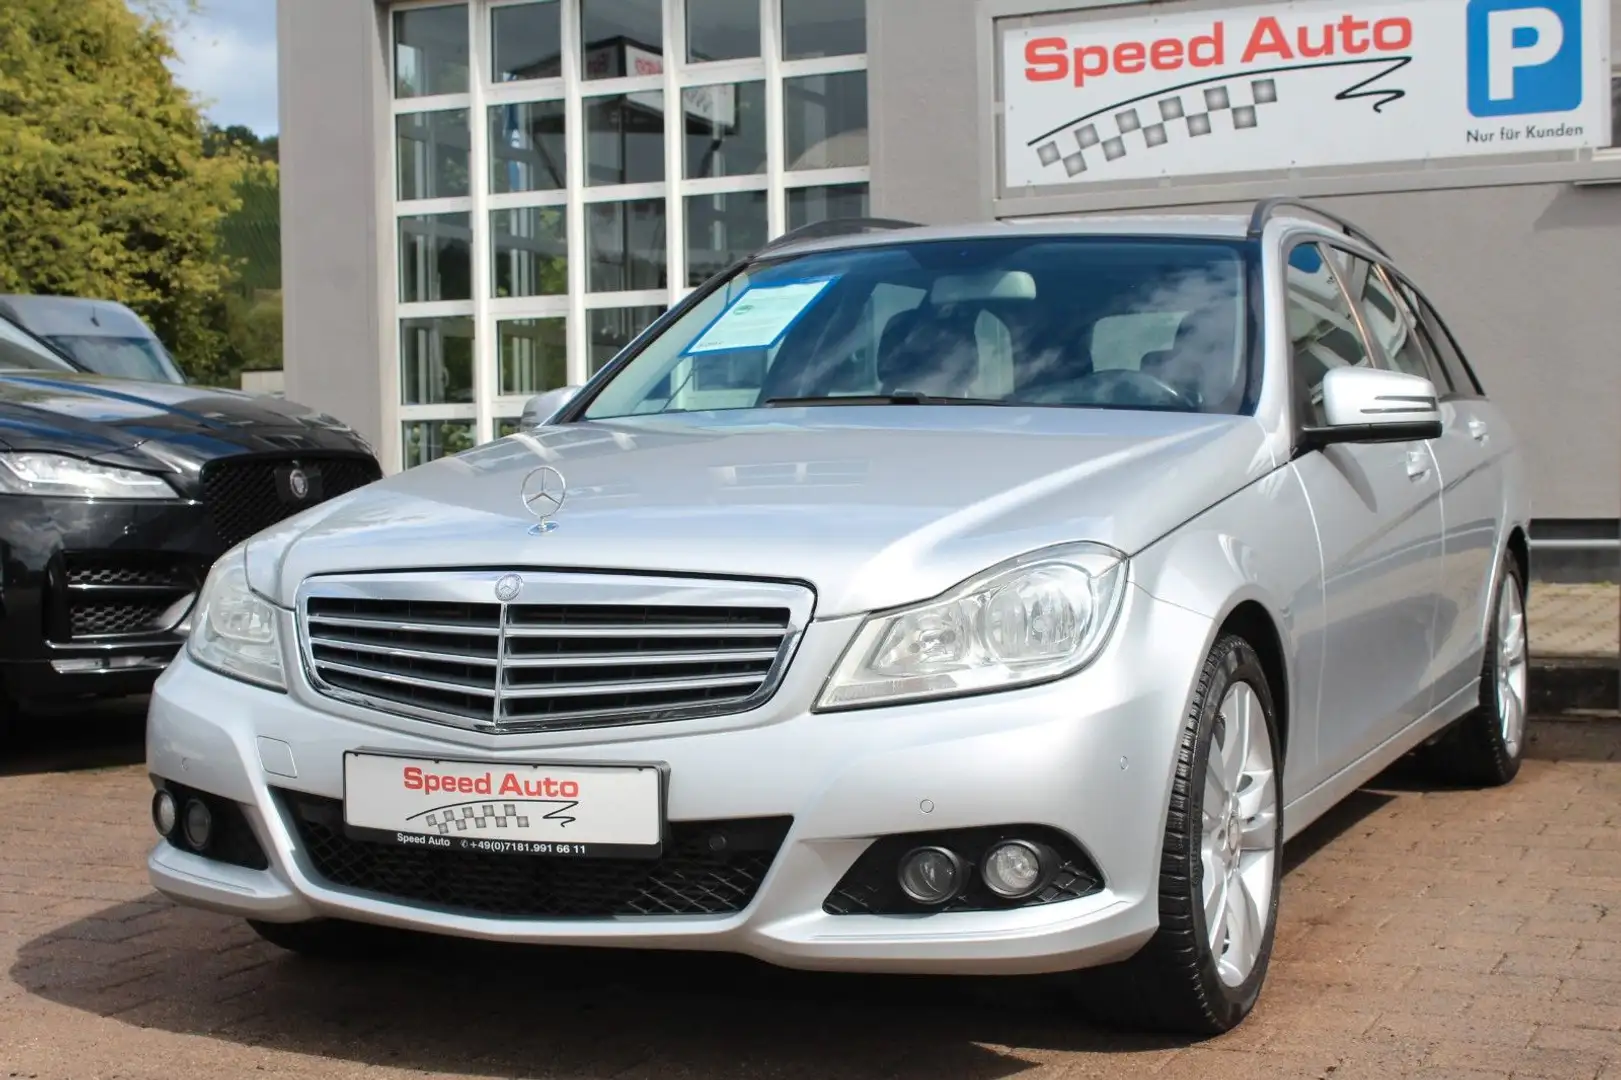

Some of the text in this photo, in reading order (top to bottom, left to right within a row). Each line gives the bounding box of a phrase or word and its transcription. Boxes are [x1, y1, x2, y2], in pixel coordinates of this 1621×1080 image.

[1024, 14, 1414, 88] Speed Auto
[1487, 6, 1565, 102] P
[1466, 122, 1584, 143] Nur für Kunden
[403, 766, 579, 799] Speed Auto
[397, 833, 426, 846] Speed
[428, 836, 451, 848] Auto
[556, 844, 571, 854] 66
[574, 845, 586, 854] 11
